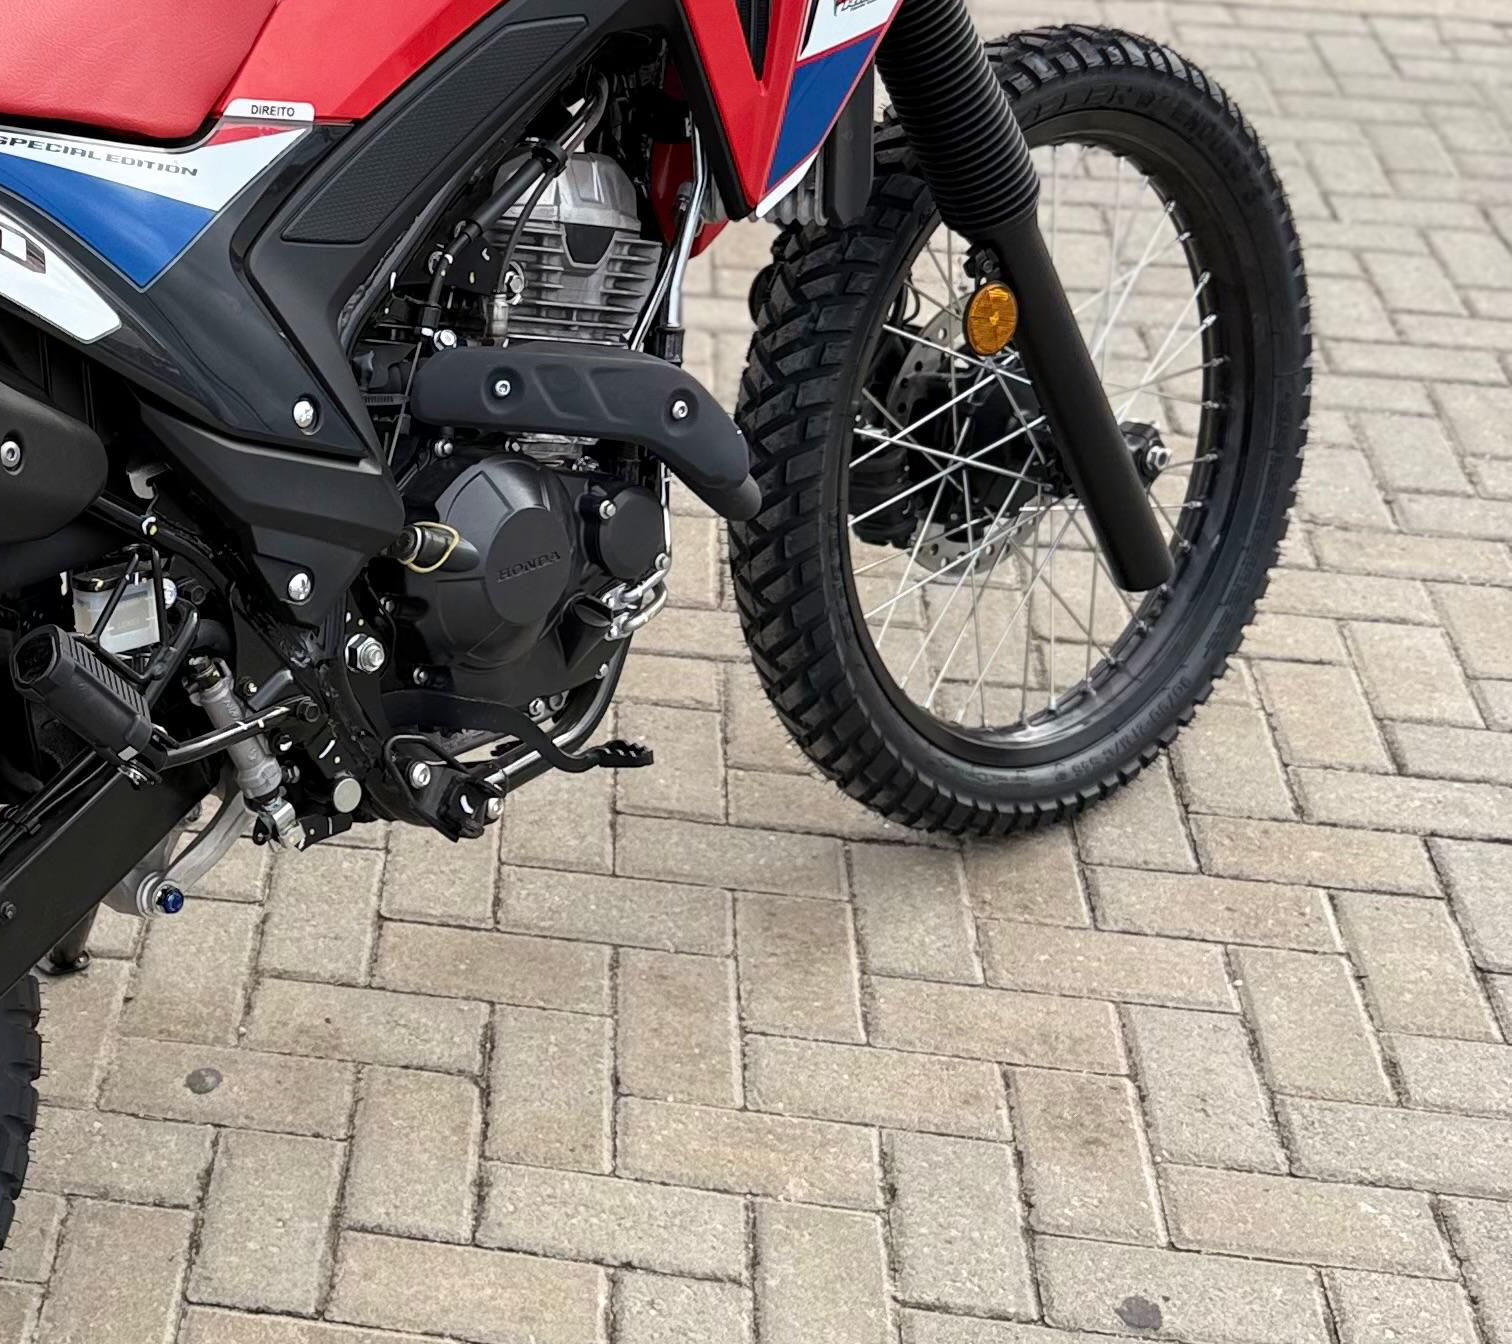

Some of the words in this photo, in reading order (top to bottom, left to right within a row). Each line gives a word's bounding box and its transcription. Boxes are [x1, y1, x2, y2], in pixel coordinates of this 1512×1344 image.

[251, 105, 295, 117] DIREITO
[106, 154, 198, 176] EDITION
[496, 551, 560, 583] HONDA
